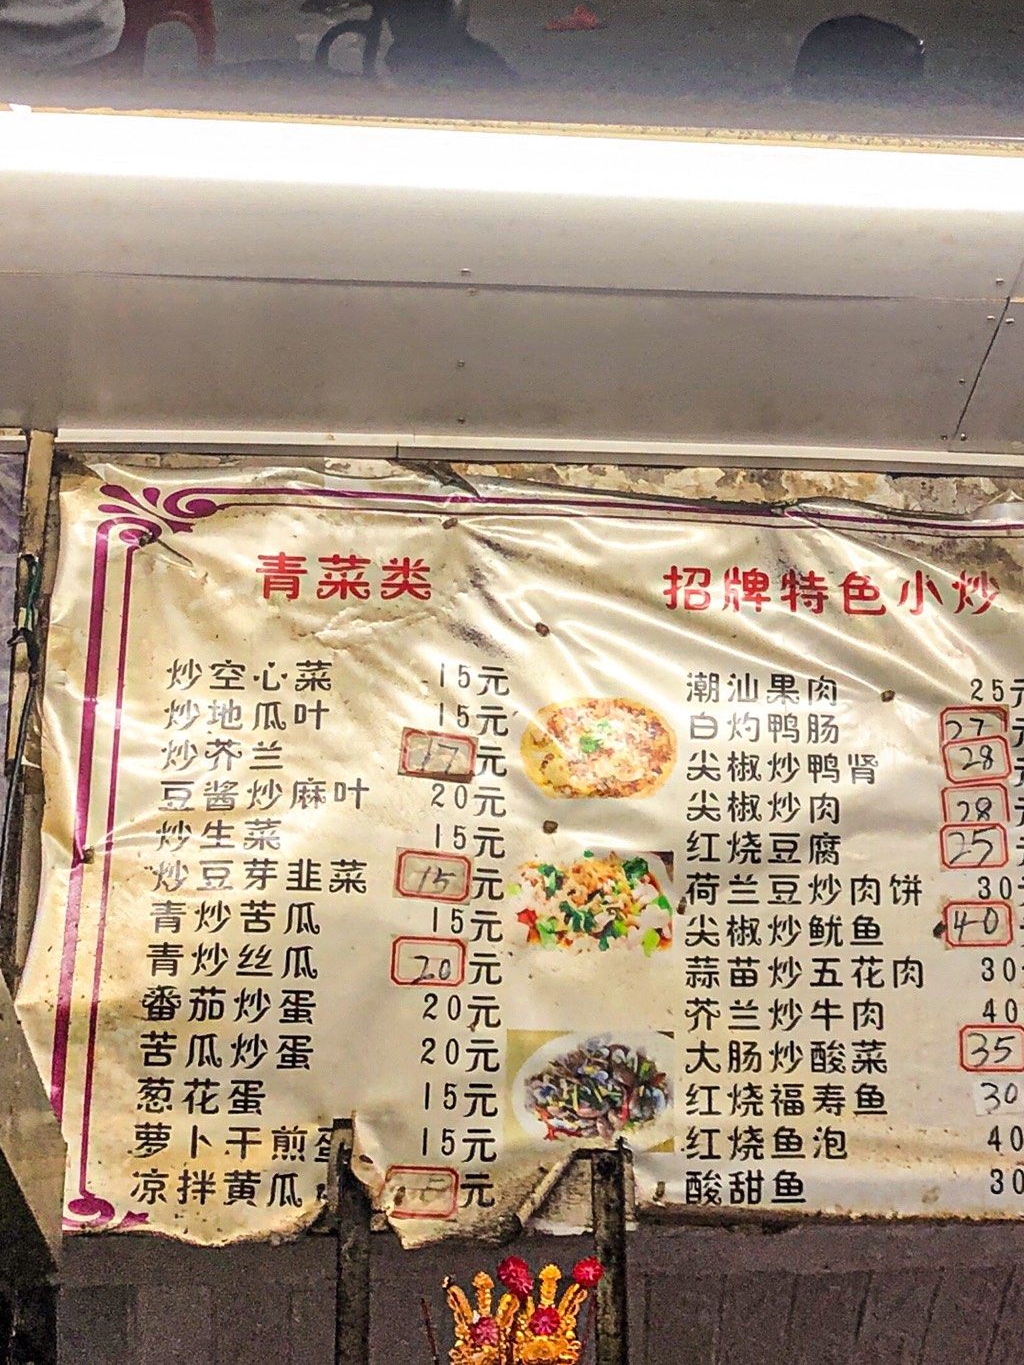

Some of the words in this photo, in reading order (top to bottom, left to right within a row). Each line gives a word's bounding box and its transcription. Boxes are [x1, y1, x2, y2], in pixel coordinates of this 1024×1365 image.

[256, 551, 431, 600] 青菜类
[663, 565, 999, 616] 招牌特色小炒
[167, 659, 332, 691] 炒空心菜
[439, 663, 509, 696] 15元
[687, 672, 838, 705] 潮汕果肉
[164, 699, 329, 731] 炒地瓜叶
[438, 703, 508, 736] 15元
[690, 712, 839, 744] 白灼鸭肠
[161, 738, 282, 772] 炒芥兰
[687, 750, 879, 786] 尖椒炒鸭肾
[159, 777, 369, 811] 豆酱炒麻叶
[431, 784, 507, 818] 20元
[687, 790, 840, 825] 尖椒炒肉
[156, 819, 281, 851] 炒生菜
[434, 823, 505, 858] 15元
[687, 831, 841, 865] 红烧豆腐
[153, 858, 367, 893] 炒豆芽韭菜
[686, 872, 922, 906] 荷兰豆炒肉饼
[150, 899, 320, 935] 青炒苦瓜
[432, 910, 502, 942] 15元
[686, 914, 883, 948] 尖椒炒鱿鱼
[146, 941, 318, 979] 青炒丝瓜
[686, 955, 923, 989] 蒜苗炒五花肉
[142, 985, 317, 1025] 番茄炒蛋
[424, 993, 501, 1029] 20元
[686, 998, 883, 1031] 芥兰炒牛肉
[139, 1032, 314, 1071] 苦瓜炒蛋
[421, 1038, 500, 1073] 20元
[686, 1040, 887, 1075] 大肠炒酸菜
[137, 1077, 266, 1116] 葱花蛋
[424, 1082, 498, 1118] 15元
[686, 1082, 887, 1116] 红烧福寿鱼
[421, 1127, 496, 1163] 15元
[686, 1126, 848, 1160] 红烧鱼泡
[131, 1168, 303, 1208] 凉拌黄瓜
[686, 1170, 806, 1205] 酸甜鱼
